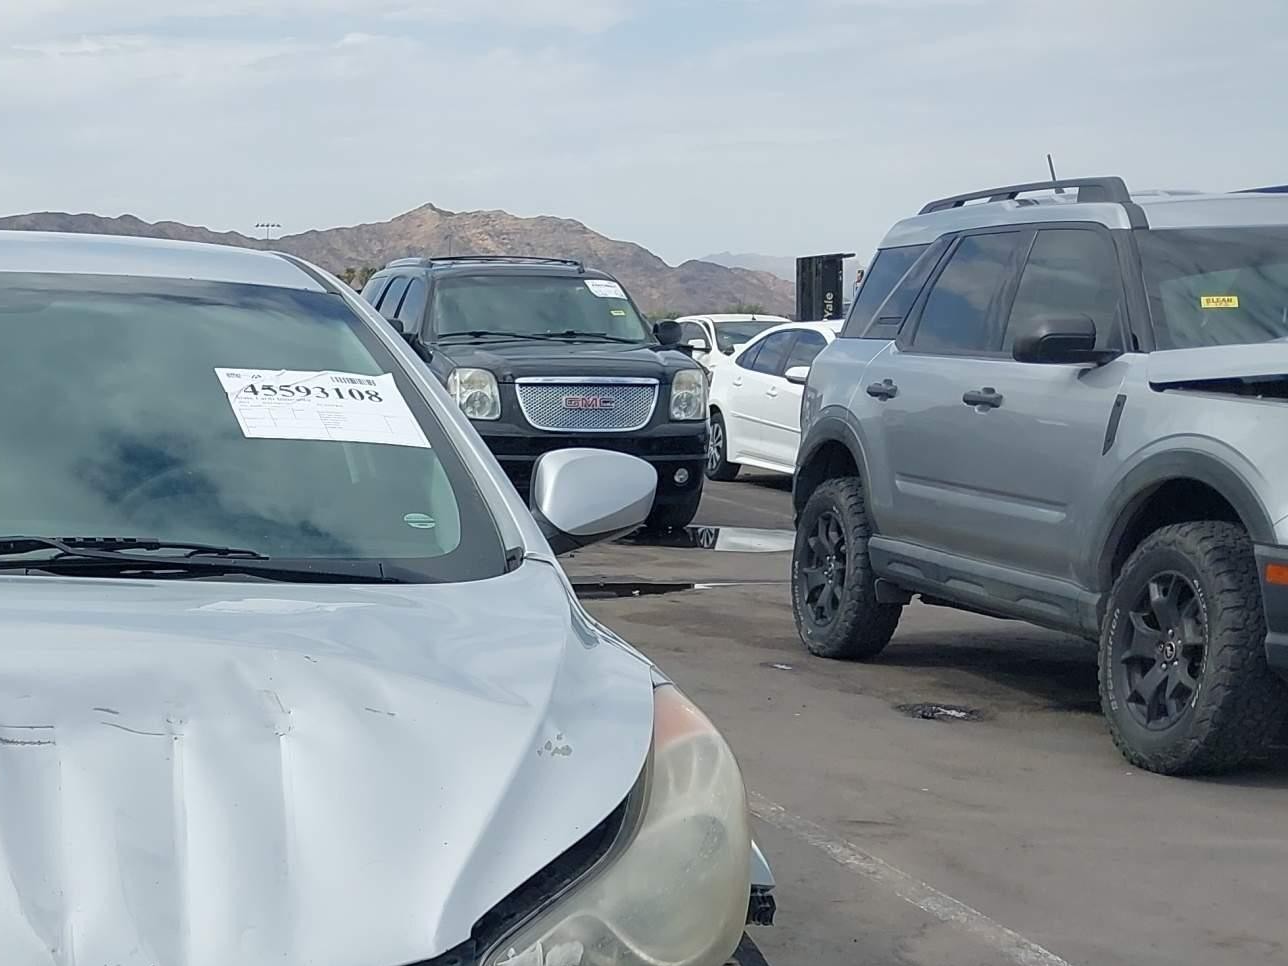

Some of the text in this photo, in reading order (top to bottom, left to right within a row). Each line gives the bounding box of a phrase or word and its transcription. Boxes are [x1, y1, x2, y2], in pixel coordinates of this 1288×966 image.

[823, 292, 834, 319] Yale
[243, 383, 384, 403] 45593108
[563, 396, 615, 409] GMC
